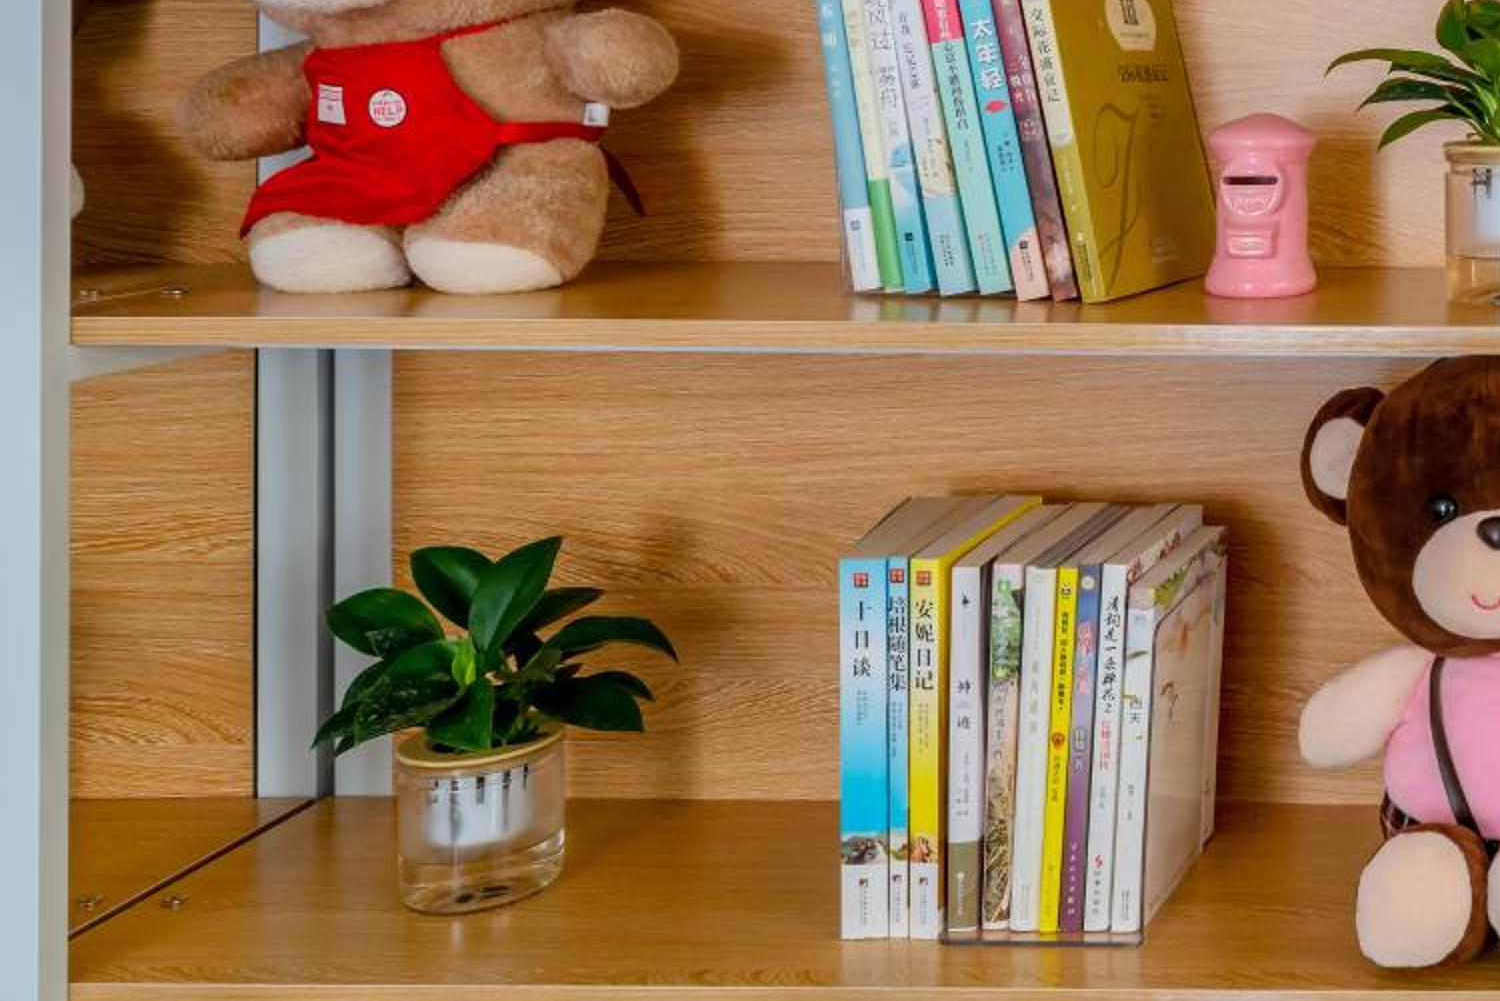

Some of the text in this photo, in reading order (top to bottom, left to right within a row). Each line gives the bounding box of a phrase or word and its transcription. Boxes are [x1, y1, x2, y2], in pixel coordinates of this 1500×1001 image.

[852, 600, 873, 678] 十日谈
[888, 596, 907, 692] 培根随笔集
[914, 599, 935, 691] 安妮日记
